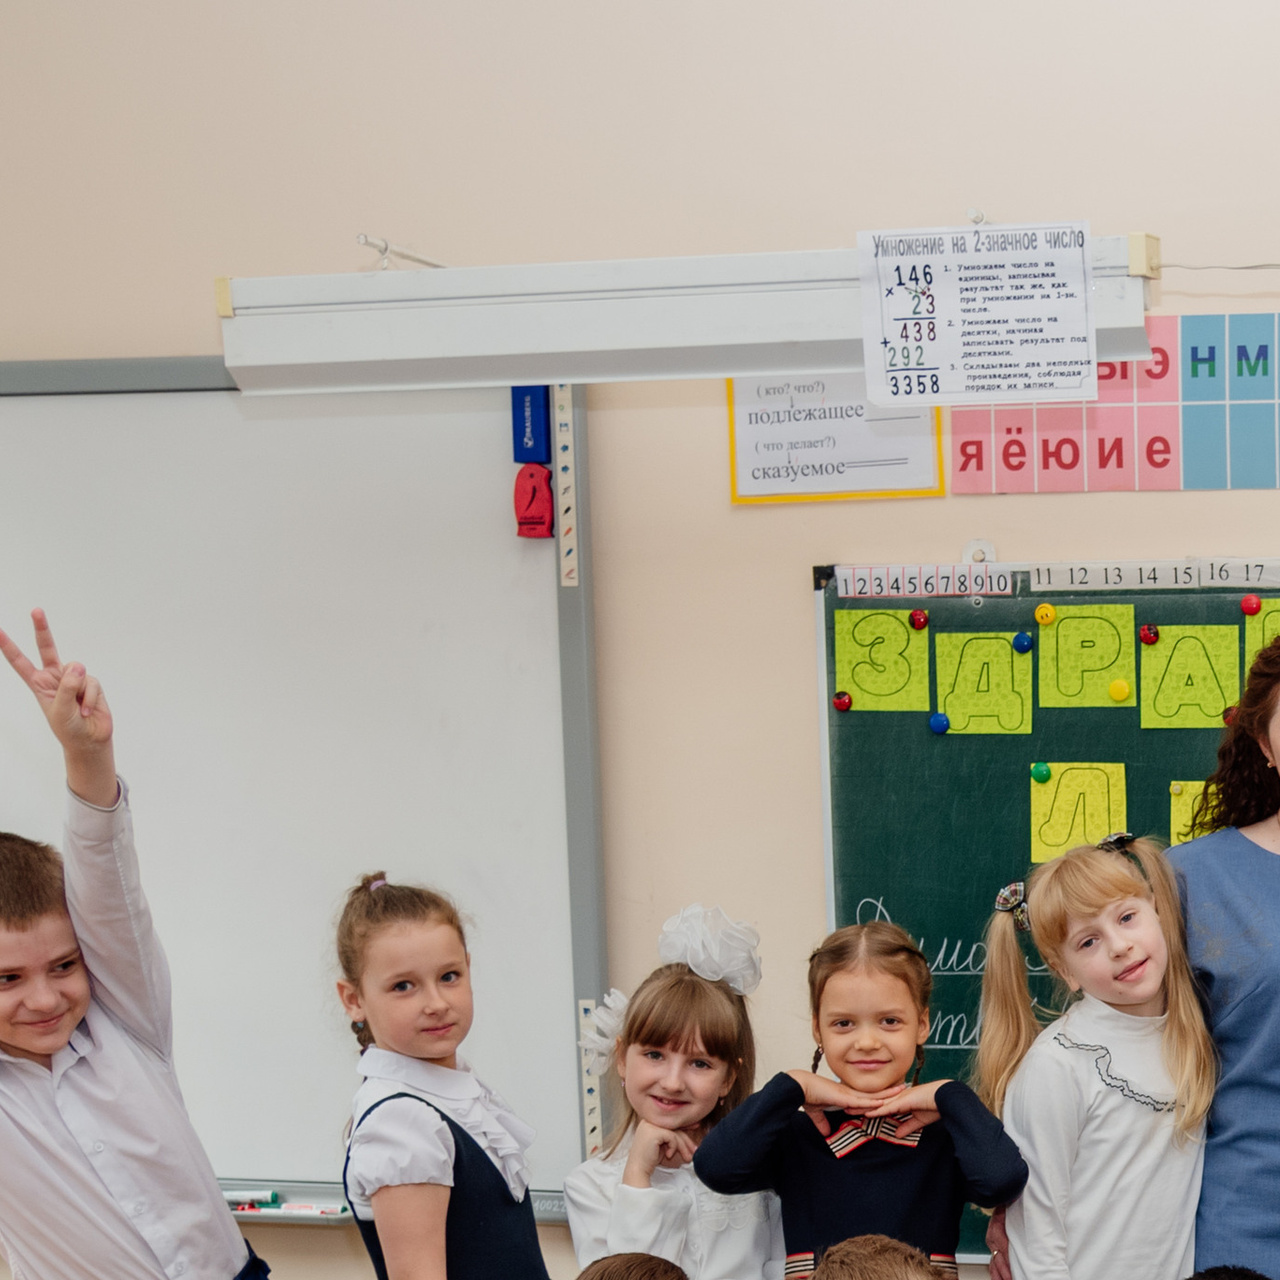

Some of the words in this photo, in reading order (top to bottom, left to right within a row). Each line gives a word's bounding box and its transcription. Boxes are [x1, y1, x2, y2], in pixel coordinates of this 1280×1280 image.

[872, 235, 944, 258] Умножение
[952, 236, 967, 254] на
[973, 230, 1038, 253] 2-значное
[1045, 230, 1085, 249] число
[894, 264, 933, 287] 146
[957, 264, 1006, 272] Умножаем
[1008, 272, 1056, 280] записывая
[959, 284, 1004, 294] результат
[912, 294, 935, 315] 23
[960, 296, 977, 304] при
[982, 294, 1034, 304] умножении
[961, 318, 1009, 326] Умножаем
[900, 321, 936, 342] 438
[962, 338, 1014, 347] записывать
[1020, 337, 1065, 346] результат
[888, 345, 924, 367] 292
[963, 362, 1020, 370] Складываем
[1037, 369, 1081, 377] соблюдая
[890, 374, 939, 396] 3358
[965, 383, 1002, 392] порядок
[748, 404, 864, 425] подлежащее
[763, 442, 783, 451] что
[786, 436, 836, 451] делает?)
[751, 461, 846, 482] сказуемое
[1036, 567, 1053, 585] 11
[1069, 567, 1089, 585] 12
[1103, 567, 1123, 585] 13
[1138, 566, 1158, 584] 14
[1173, 566, 1193, 584] 15
[1209, 562, 1229, 581] 16
[1244, 564, 1264, 582] 17
[843, 578, 849, 595] 1
[857, 578, 868, 595] 2
[874, 577, 884, 595] 3
[890, 577, 901, 594] 4
[907, 576, 917, 594] 5
[924, 575, 935, 593] 6
[940, 576, 951, 593] 7
[958, 574, 968, 593] 8
[974, 574, 985, 592] 9
[988, 574, 1008, 592] 10
